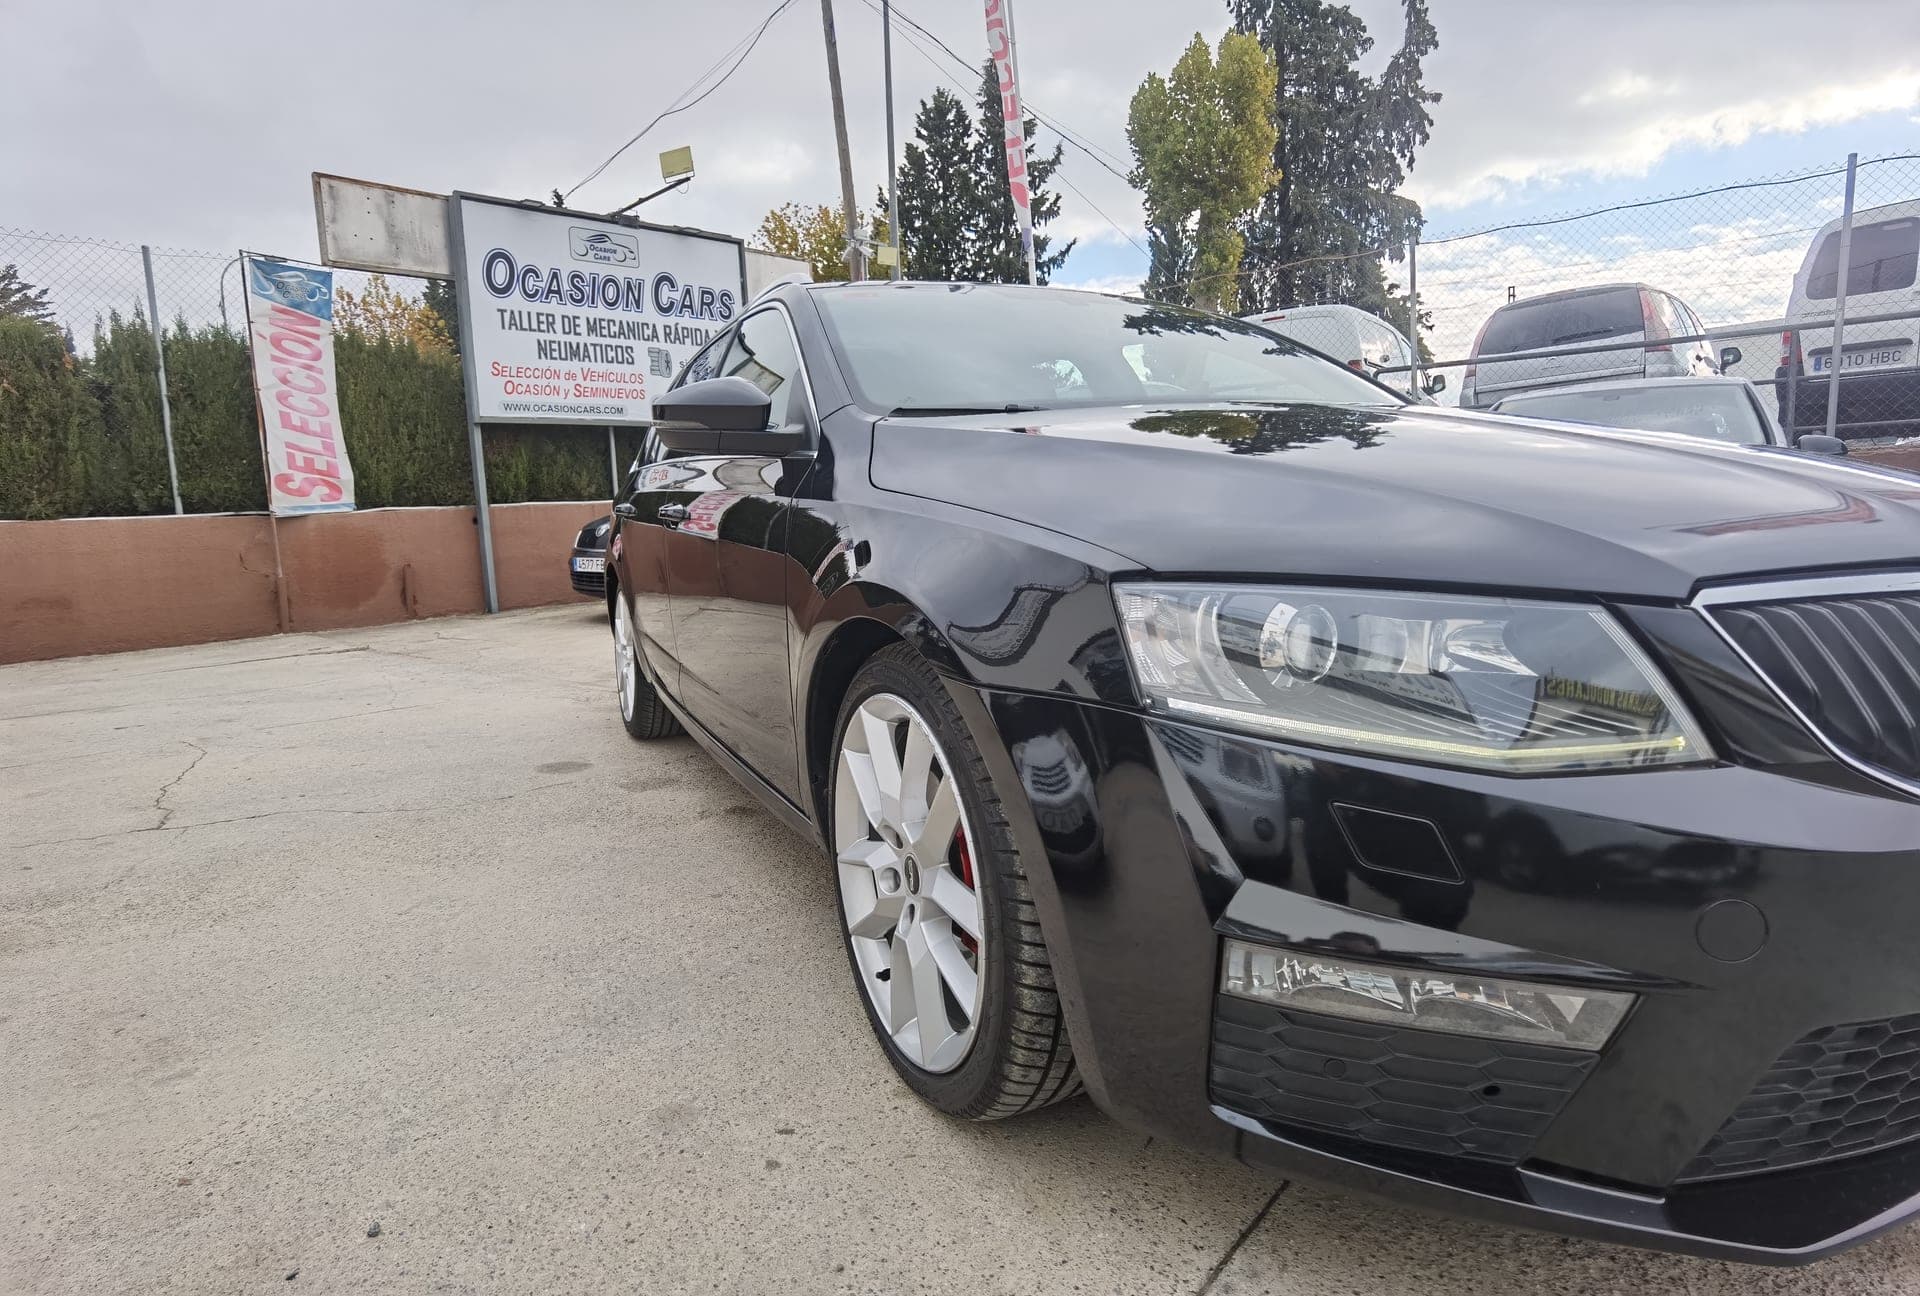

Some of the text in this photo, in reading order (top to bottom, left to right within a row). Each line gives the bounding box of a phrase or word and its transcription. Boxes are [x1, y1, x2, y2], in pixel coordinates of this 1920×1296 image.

[482, 248, 735, 323] OCASION CARS
[497, 308, 711, 346] TALLER DE MECANICA RÁPIDA
[537, 338, 635, 365] NEUMATICOS
[1870, 350, 1902, 364] HBC
[491, 361, 644, 385] SELECCIÓN de VEHÍCULOS
[504, 379, 646, 400] OCASIÓN y SEMINUEVOS
[257, 304, 343, 502] SELECCIÓN
[503, 402, 625, 416] WWW.OCASIONCARS.COM
